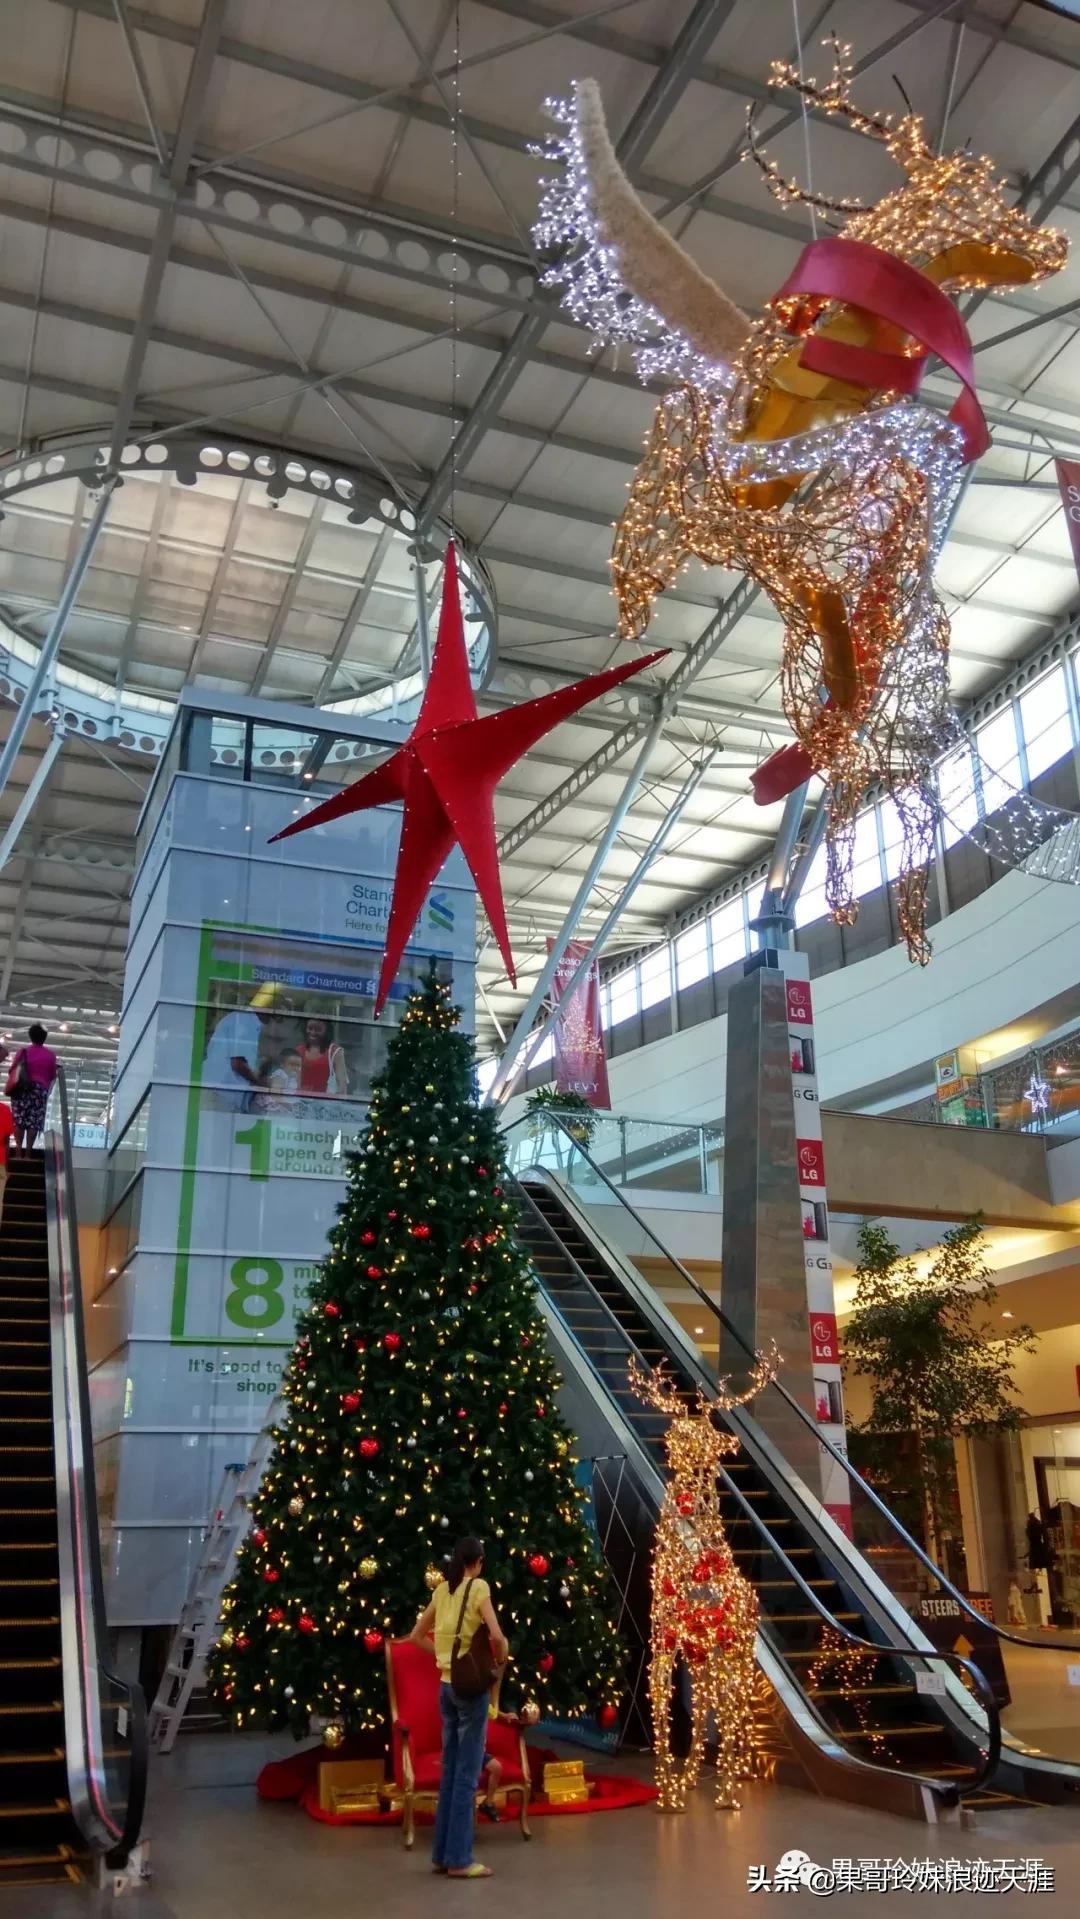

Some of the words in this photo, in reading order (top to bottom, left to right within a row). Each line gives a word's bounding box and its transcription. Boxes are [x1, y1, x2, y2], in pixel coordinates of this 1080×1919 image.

[345, 919, 373, 931] Here
[252, 969, 304, 984] Standard
[307, 975, 362, 990] Chartered
[790, 1007, 805, 1018] LG
[568, 1082, 598, 1093] LEVY
[235, 1119, 271, 1182] 1
[275, 1147, 317, 1161] open
[802, 1169, 818, 1180] LG
[225, 1257, 285, 1330] 8
[815, 1345, 832, 1357] LG
[189, 1360, 214, 1372] It's
[220, 1361, 260, 1376] good
[266, 1361, 281, 1374] to
[237, 1379, 277, 1395] shop
[921, 1599, 960, 1616] STEERS
